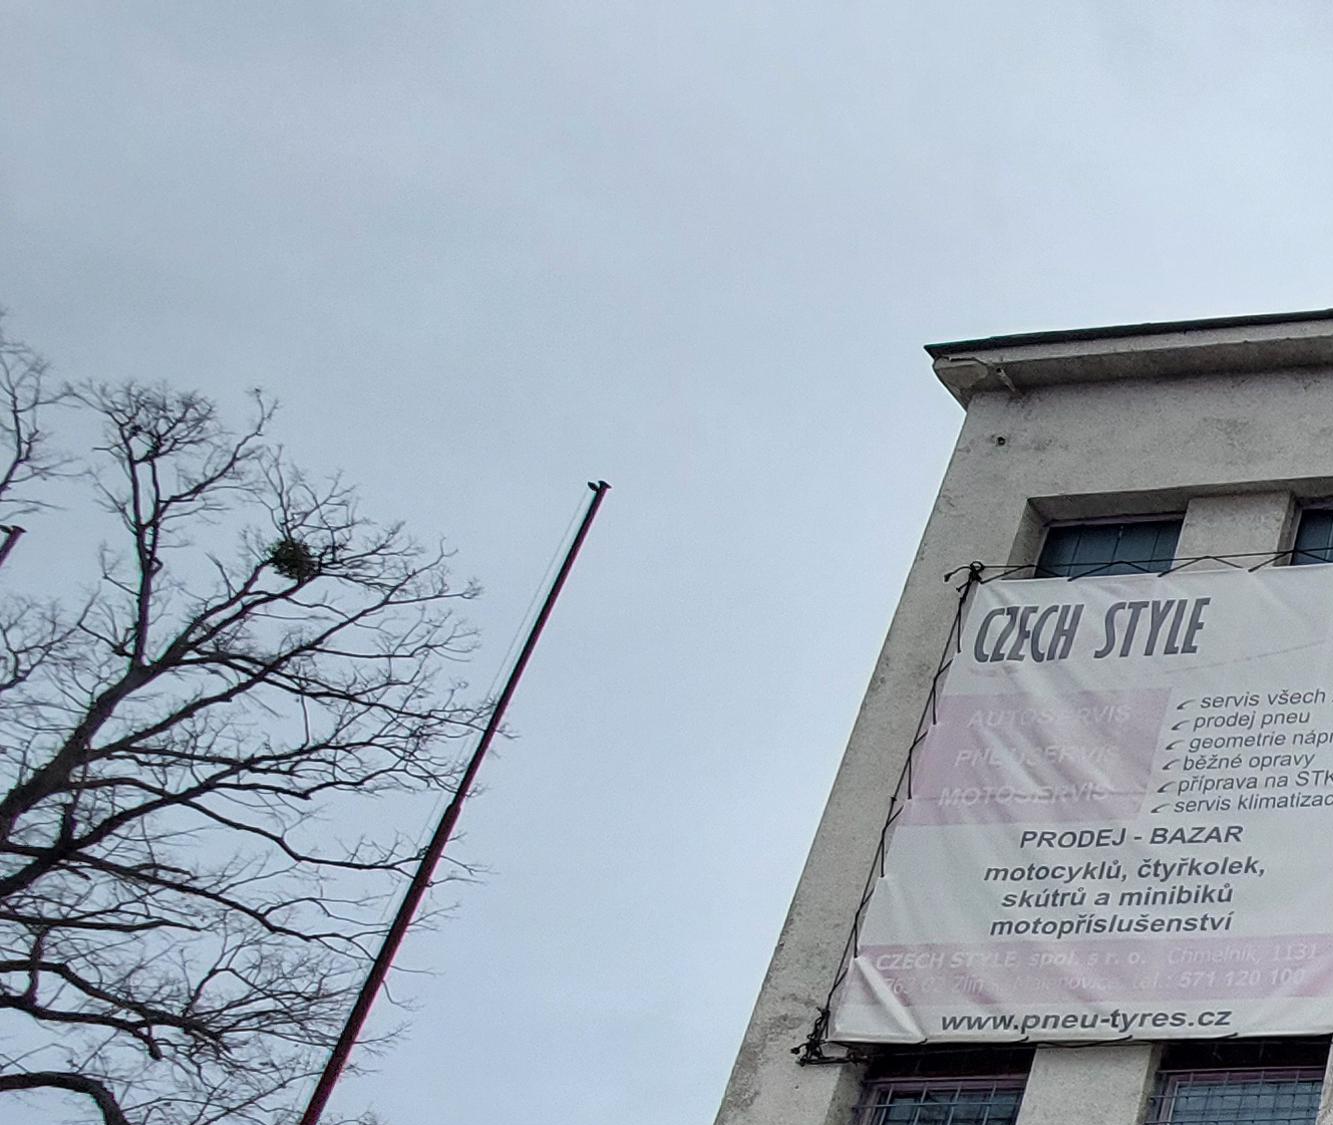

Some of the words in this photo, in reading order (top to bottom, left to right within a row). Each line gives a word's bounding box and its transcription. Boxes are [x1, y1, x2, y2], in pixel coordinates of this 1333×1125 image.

[974, 604, 1084, 663] CZECH
[1093, 598, 1211, 658] STYLE
[1200, 691, 1260, 709] servis
[1267, 688, 1326, 705] všech
[967, 705, 1132, 728] AUTOSERVIS
[1193, 712, 1255, 732] prodej
[1261, 711, 1310, 728] pneu
[1188, 731, 1286, 752] geometrie
[1183, 753, 1242, 771] běžné
[1249, 753, 1316, 771] opravy
[1177, 775, 1258, 796] příprava
[1264, 775, 1288, 788] na
[1174, 797, 1231, 813] servis
[1020, 828, 1126, 849] PRODEJ
[1149, 826, 1243, 845] BAZAR
[984, 859, 1127, 884] motocyklů,
[1137, 856, 1265, 882] čtyřkolek,
[1001, 887, 1086, 908] skútrů
[1094, 892, 1109, 906] a
[1119, 883, 1233, 907] minibiků
[990, 911, 1234, 939] motopříslušenství
[876, 952, 945, 970] CZECH
[1028, 950, 1079, 968] spol.
[1128, 951, 1146, 965] o.
[1178, 970, 1216, 988] 571
[1224, 969, 1261, 987] 120
[1271, 967, 1307, 986] 100
[941, 1008, 1232, 1034] www.pneu-tyres.cz
